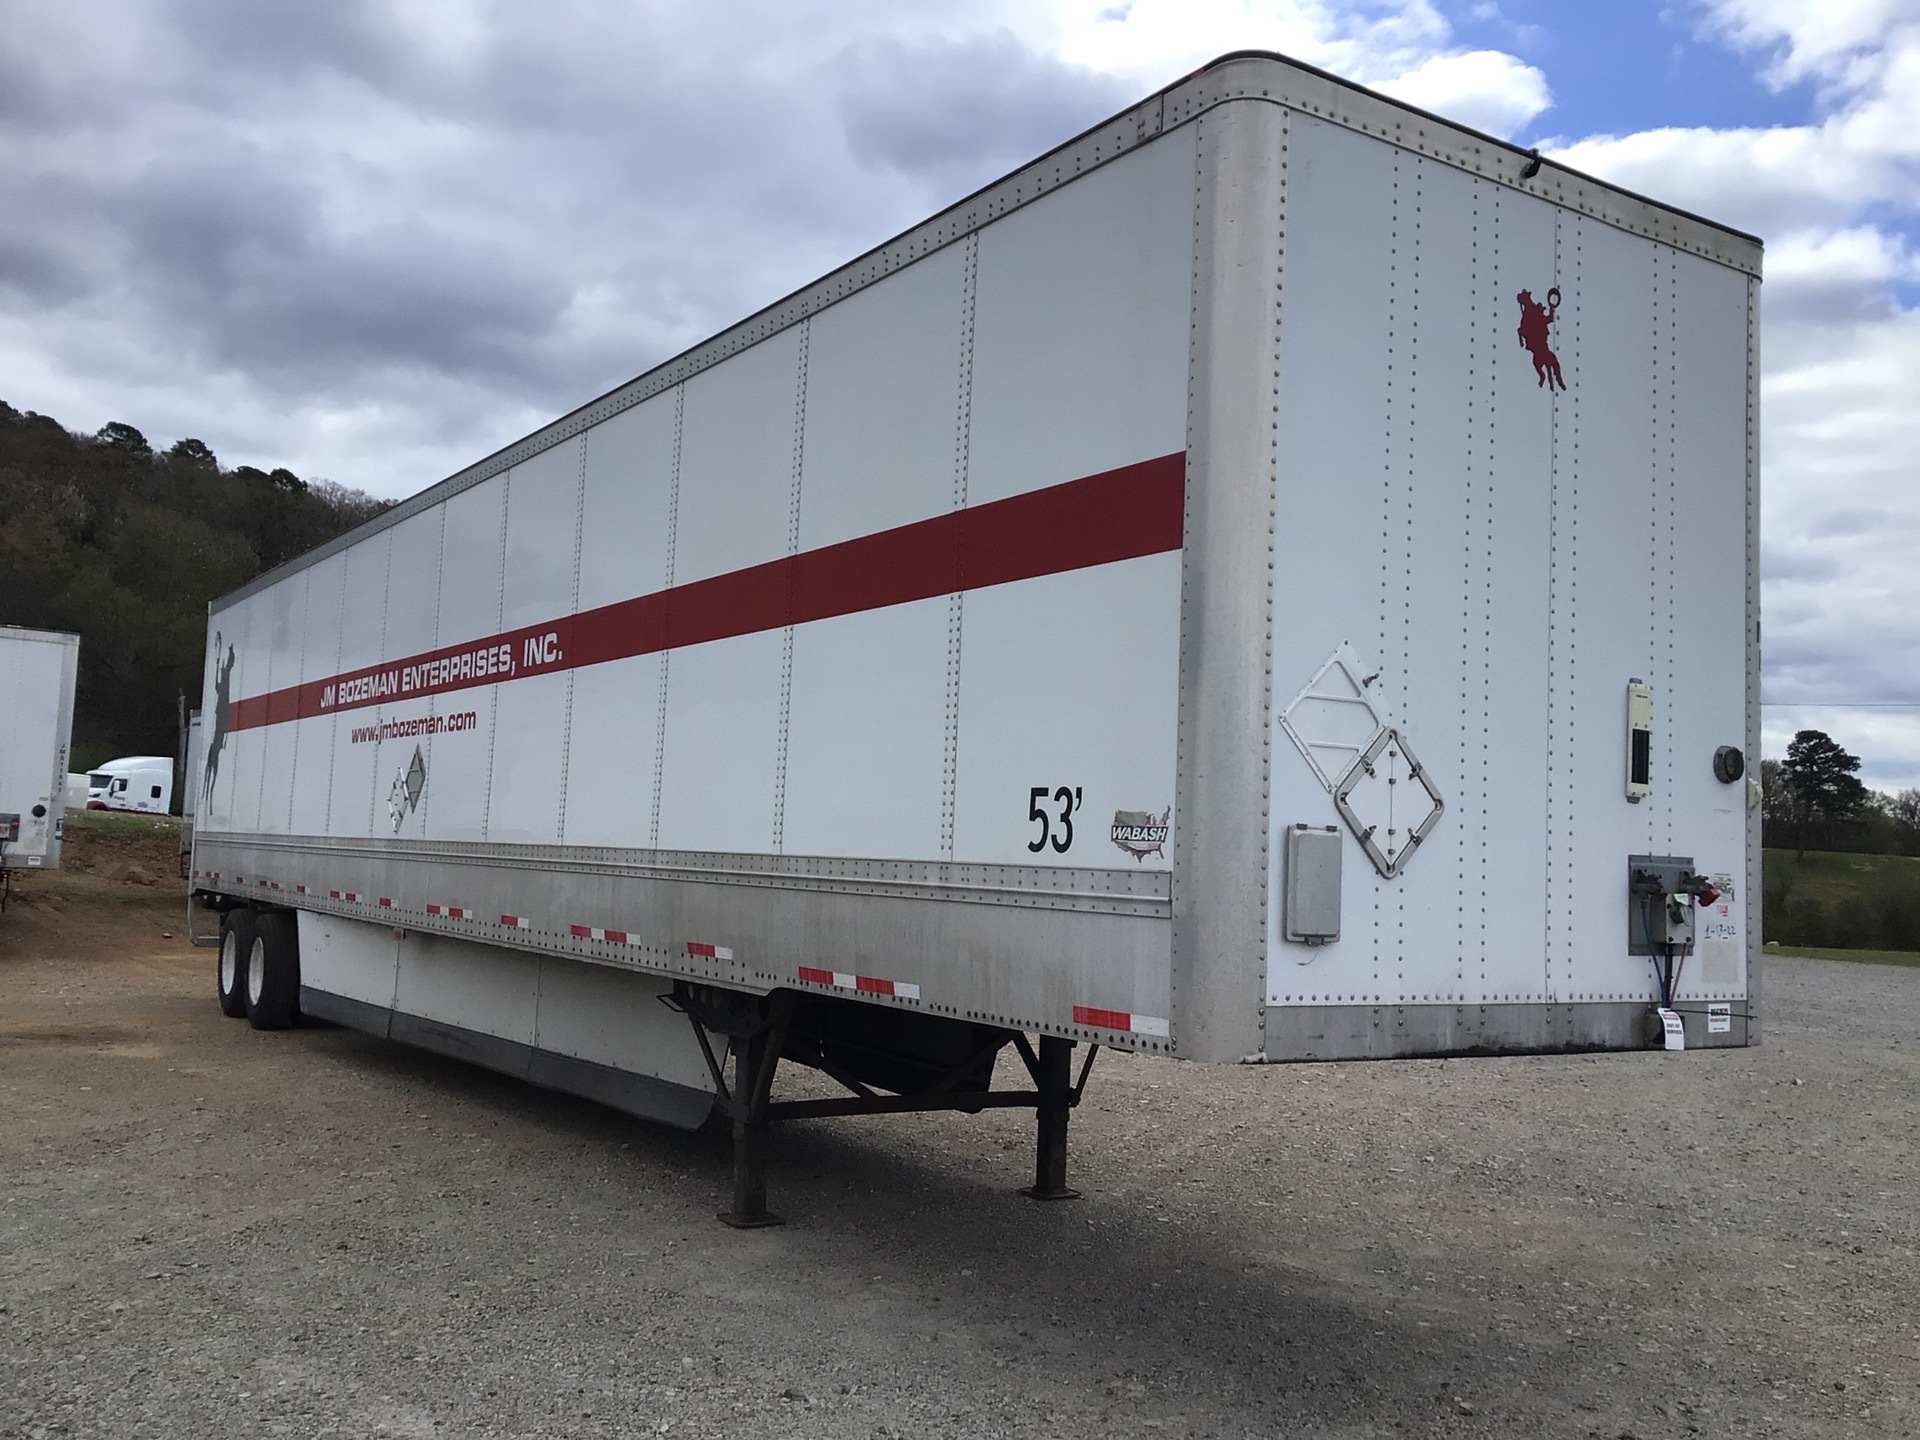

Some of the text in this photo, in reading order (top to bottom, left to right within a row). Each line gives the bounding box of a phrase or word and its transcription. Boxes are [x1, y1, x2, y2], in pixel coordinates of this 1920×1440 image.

[320, 632, 563, 709] JM BOZEMAN ENTERPRISES, INC.
[351, 710, 477, 745] www.jmbozeman.com
[1027, 786, 1083, 854] 53'
[1112, 826, 1167, 841] WABASH
